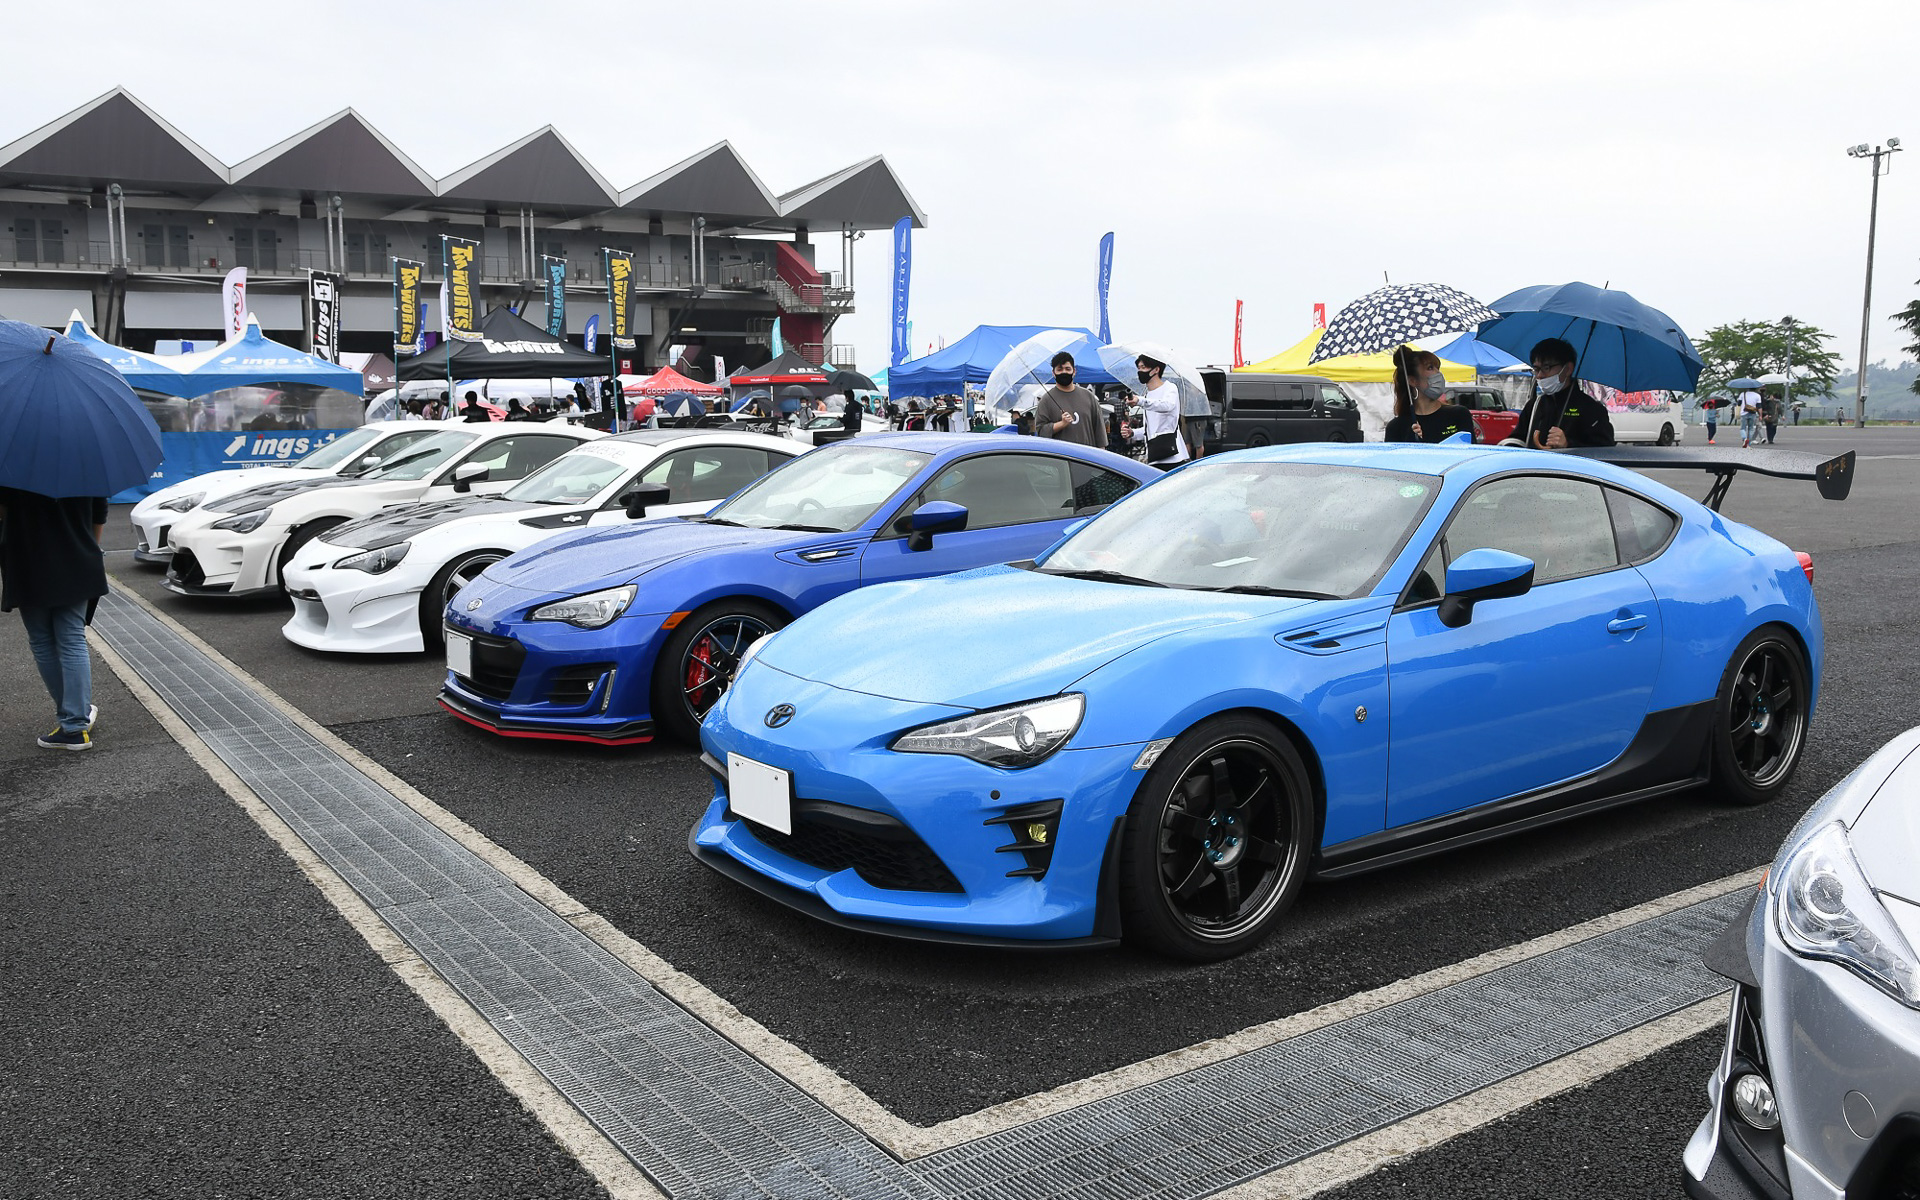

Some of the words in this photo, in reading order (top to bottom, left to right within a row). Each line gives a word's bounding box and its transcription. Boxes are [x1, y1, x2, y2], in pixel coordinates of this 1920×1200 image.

[899, 256, 907, 325] ARTISAN
[315, 301, 330, 345] ings
[242, 357, 289, 366] ings
[251, 434, 310, 459] ings
[1320, 520, 1360, 531] BRIDE
